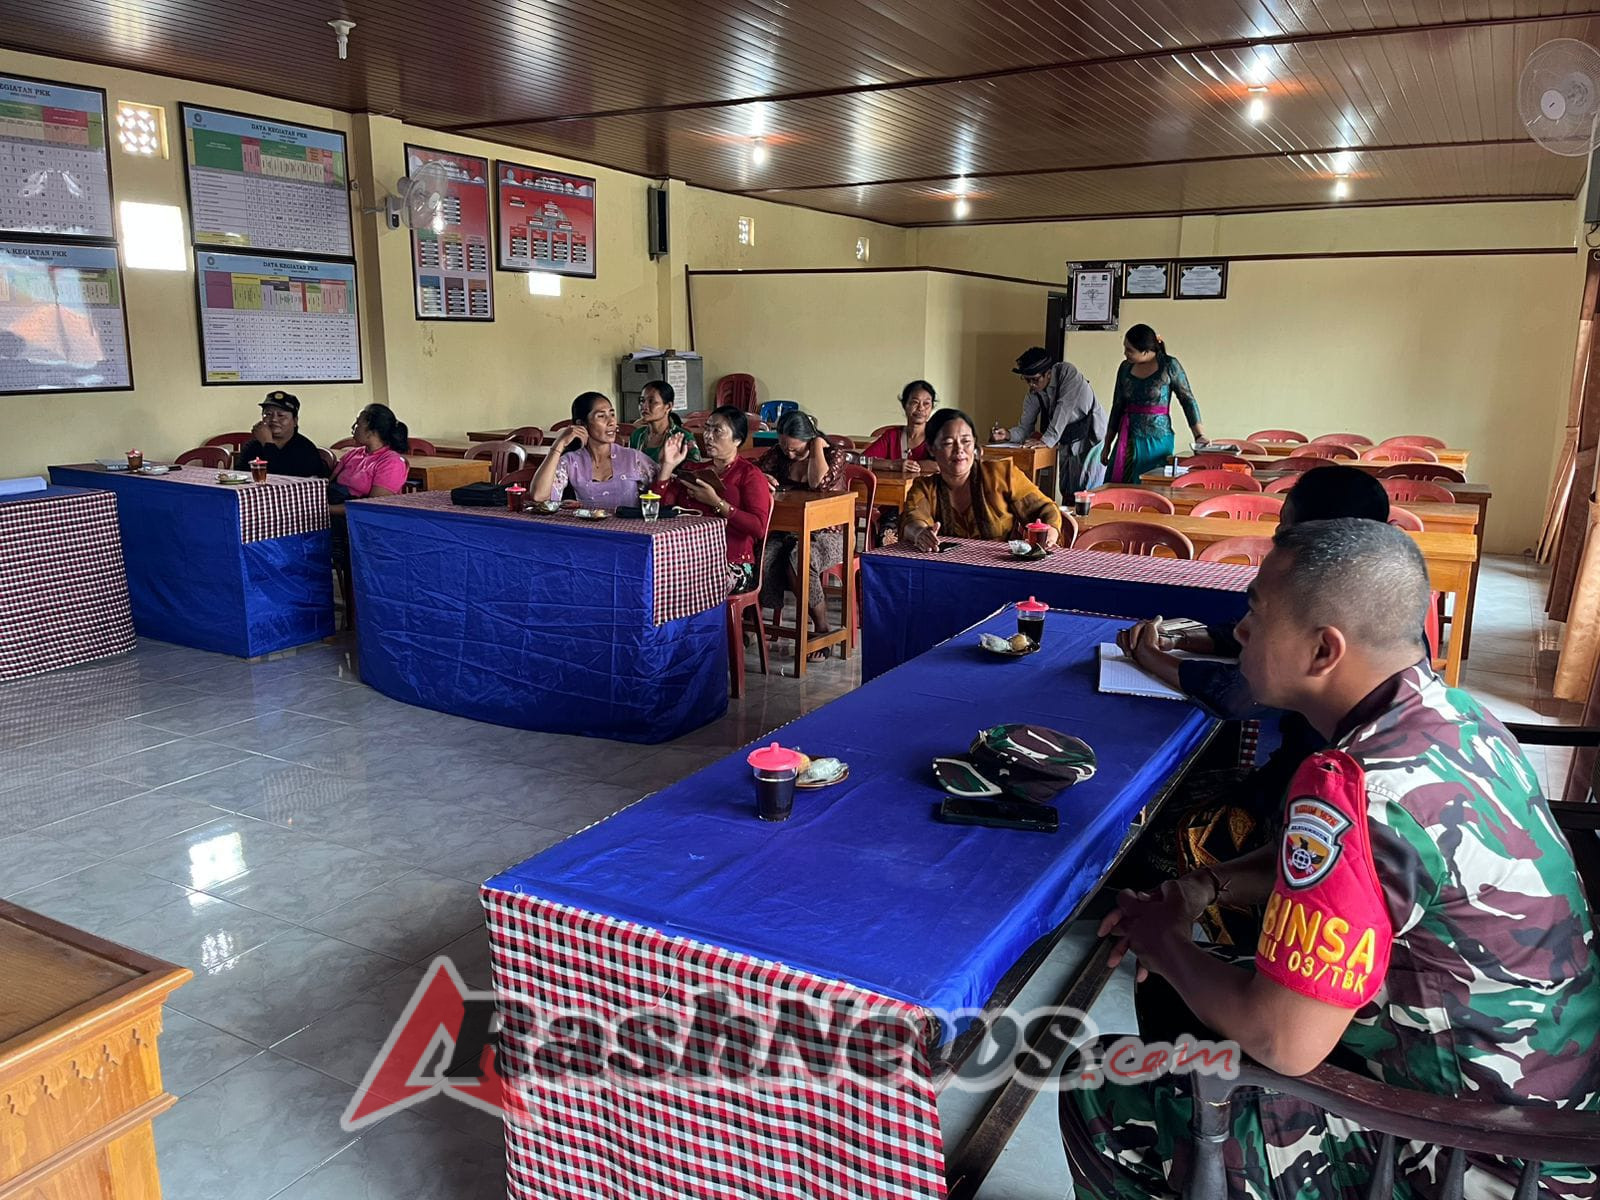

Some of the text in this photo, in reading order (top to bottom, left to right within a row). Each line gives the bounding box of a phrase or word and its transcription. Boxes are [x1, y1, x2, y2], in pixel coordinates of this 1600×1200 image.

[35, 88, 51, 97] PKK
[251, 123, 267, 131] DATA
[12, 248, 49, 256] KEGIATAN
[1288, 950, 1368, 993] 03/TBK
